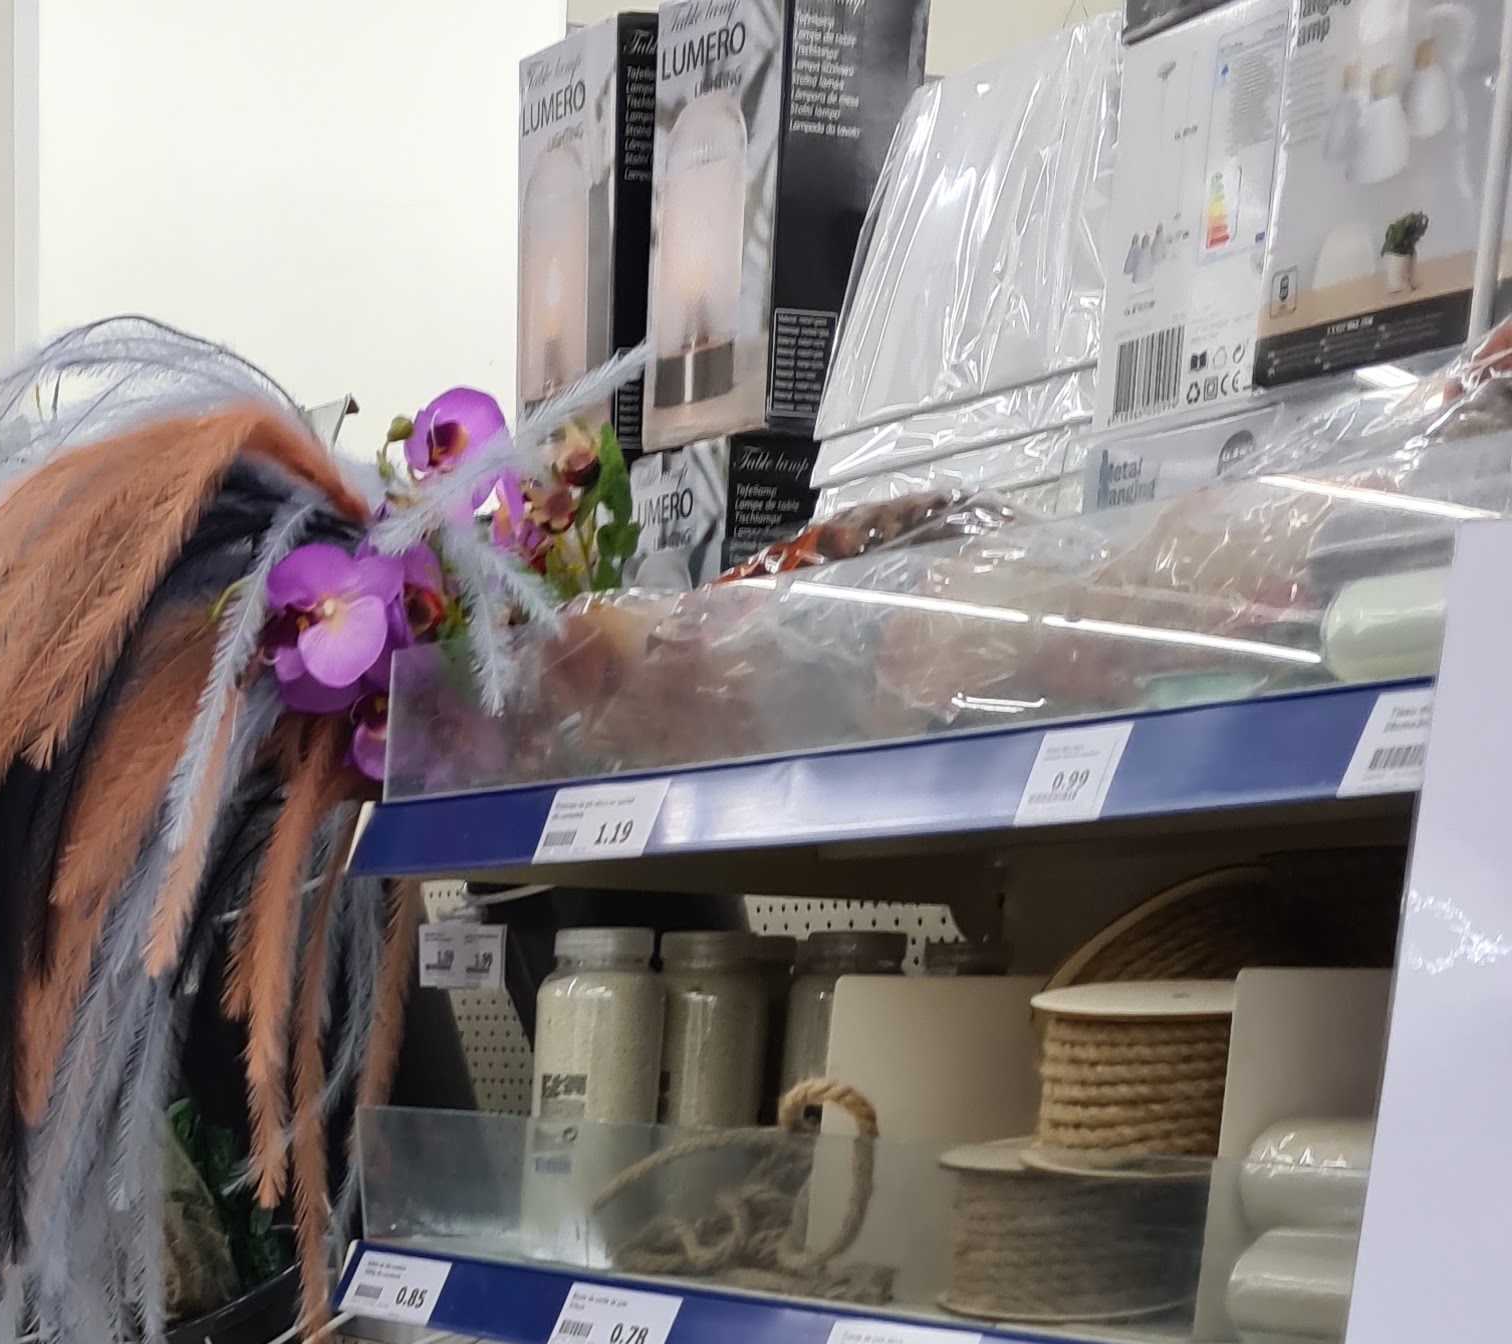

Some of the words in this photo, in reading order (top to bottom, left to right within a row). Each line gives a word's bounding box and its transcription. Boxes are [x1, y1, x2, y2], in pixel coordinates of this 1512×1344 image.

[1297, 17, 1331, 48] amp
[662, 21, 746, 81] LUMERO
[522, 80, 586, 137] LUMERO
[733, 446, 773, 472] Table
[775, 452, 809, 481] lamp
[638, 488, 693, 529] UMERO
[594, 819, 634, 845] 1.19
[396, 1286, 428, 1309] 0.85
